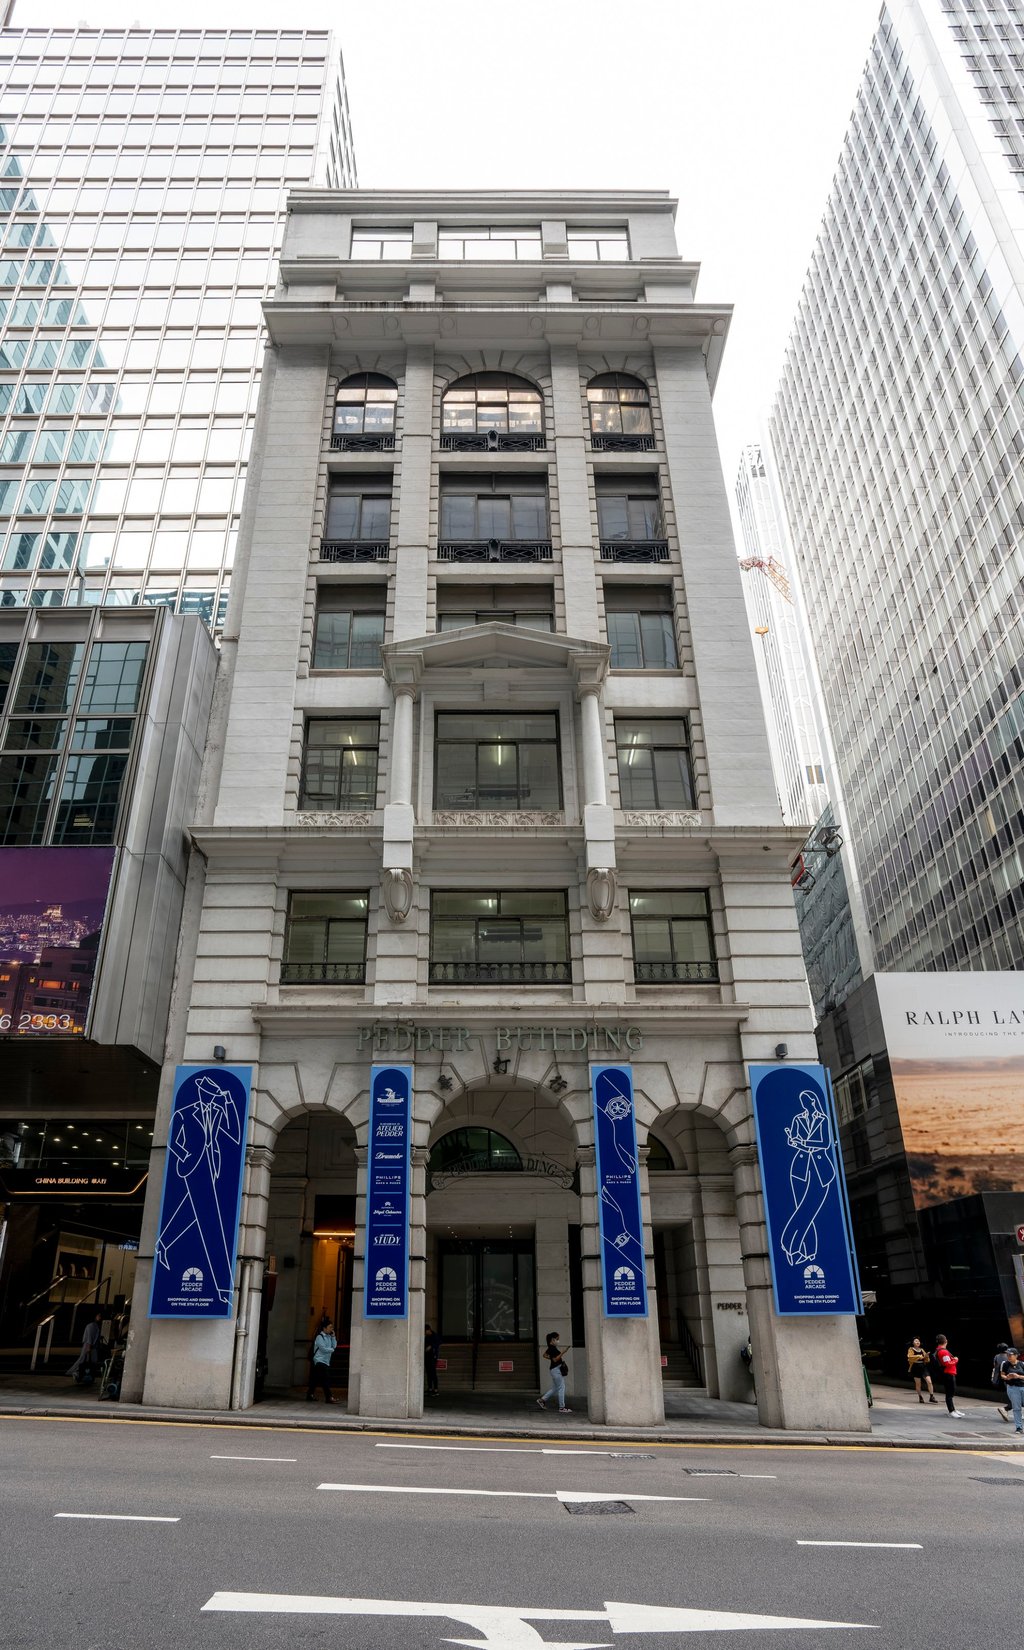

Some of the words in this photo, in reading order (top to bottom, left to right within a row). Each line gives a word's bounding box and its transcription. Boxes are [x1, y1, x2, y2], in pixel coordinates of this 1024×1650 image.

[0, 1014, 12, 1029] 6
[18, 1014, 70, 1029] 2333
[905, 1010, 980, 1025] RALPH
[992, 1010, 1024, 1024] LA
[356, 1027, 473, 1051] PEDDER
[495, 1026, 643, 1051] BUILDING
[374, 1236, 401, 1244] STUDY
